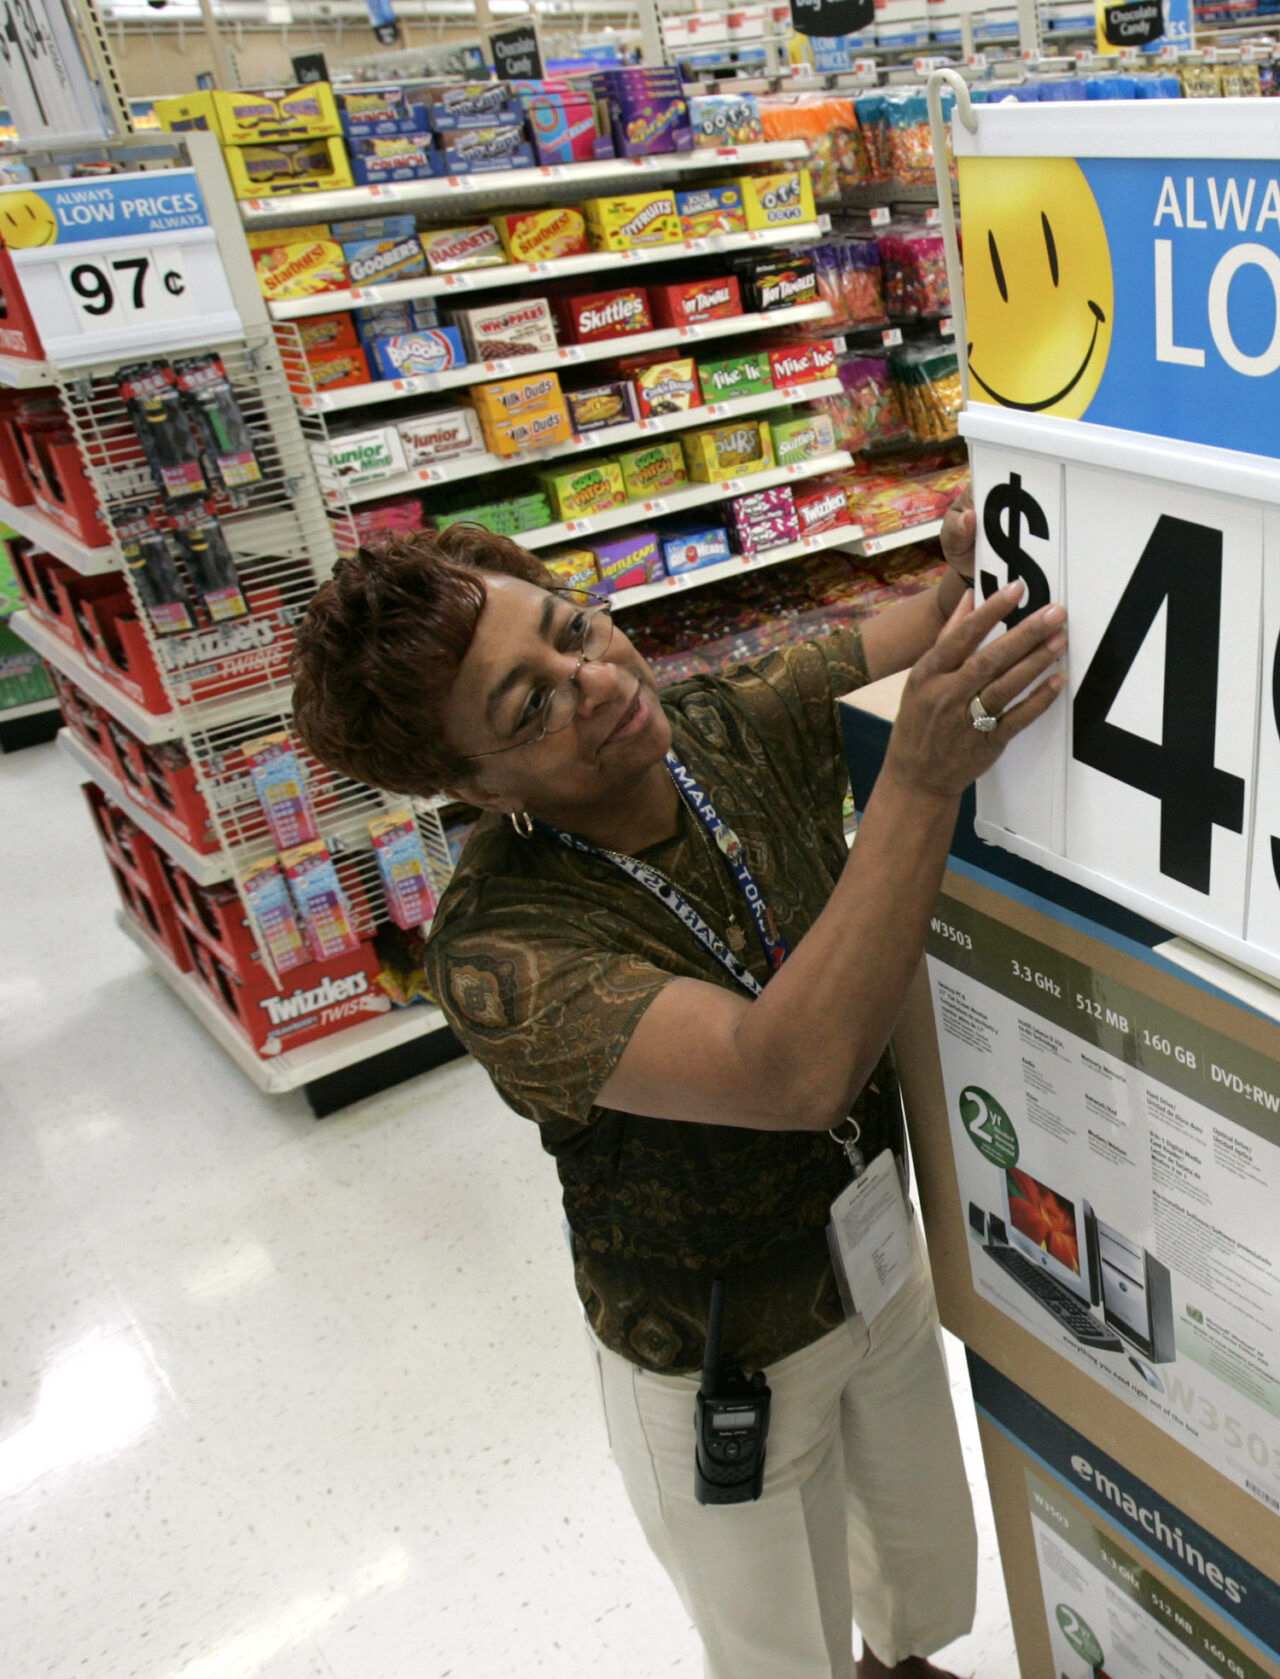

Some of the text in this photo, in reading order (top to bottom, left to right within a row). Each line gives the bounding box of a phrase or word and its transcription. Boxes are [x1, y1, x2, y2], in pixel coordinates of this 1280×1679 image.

[1110, 6, 1159, 24] Chocolate
[1120, 21, 1151, 36] Candy
[703, 103, 752, 136] DOTS
[55, 188, 115, 206] ALWAYS
[58, 193, 199, 227] LOW PRICES
[149, 213, 205, 230] ALWAYS
[351, 240, 420, 280] GOOBERS
[429, 225, 496, 265] RAISINETS
[761, 272, 816, 308] HOT TAMALES
[479, 306, 545, 334] WHOPPERS
[578, 297, 643, 334] Skittles
[773, 348, 834, 379] Mike Ike
[523, 377, 553, 399] Duds
[532, 412, 562, 434] Duds
[634, 448, 665, 469] SOUR
[777, 431, 815, 455] Skittles
[571, 469, 604, 491] SOUR
[636, 459, 673, 483] PATCH
[573, 481, 612, 507] PATCH
[801, 488, 846, 523] Twizzlers
[631, 543, 656, 566] CAPS
[930, 916, 973, 951] W3503
[1010, 960, 1063, 999] 3.3 GHz
[259, 969, 369, 1026] Twizzlers
[1075, 993, 1130, 1034] 512 MB
[1142, 1029, 1198, 1070] 160 GB
[964, 1089, 994, 1143] 2
[988, 1109, 1003, 1128] yr
[1033, 1491, 1070, 1529] W3503
[1070, 1454, 1242, 1605] emachines
[1152, 1594, 1194, 1635] 512 MB
[1203, 1637, 1245, 1679] 160 GB
